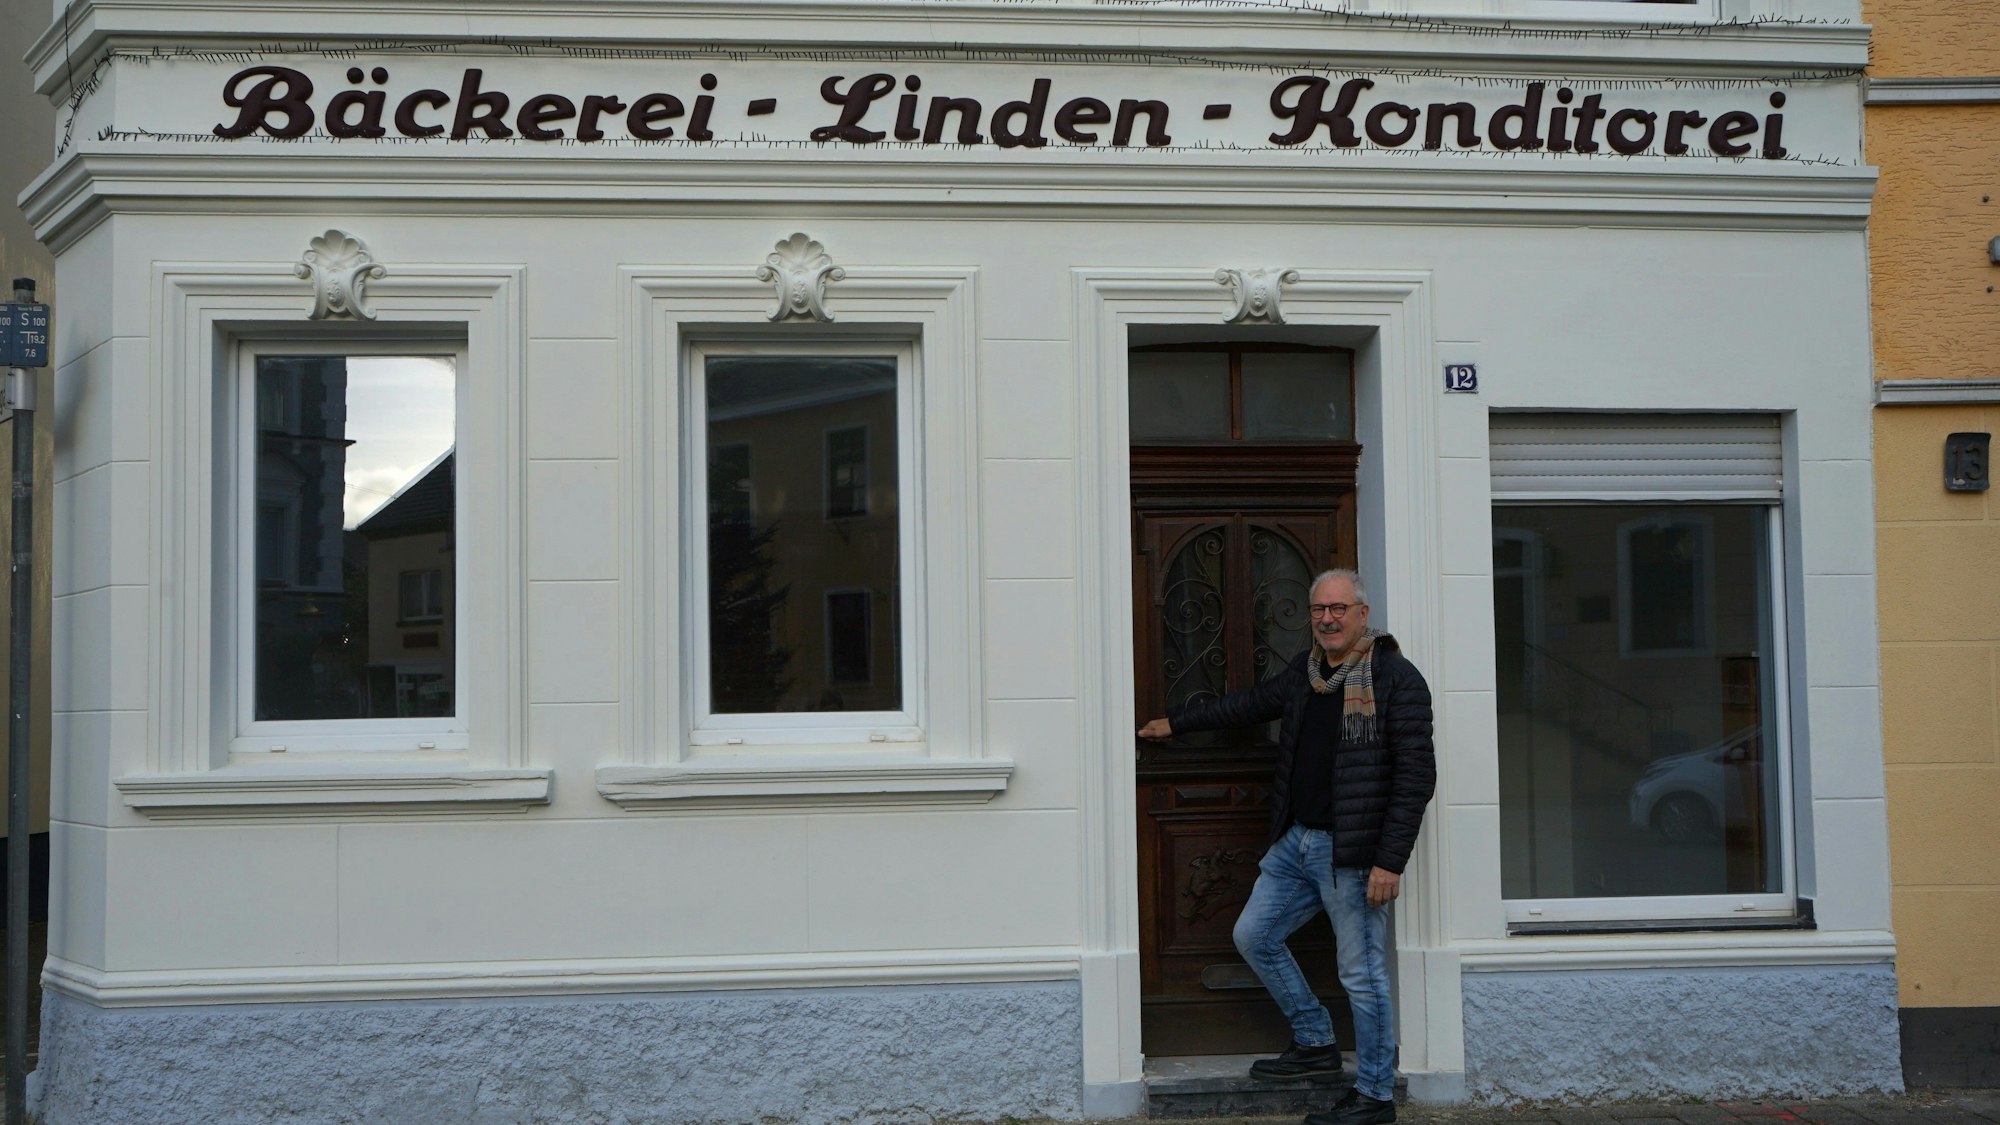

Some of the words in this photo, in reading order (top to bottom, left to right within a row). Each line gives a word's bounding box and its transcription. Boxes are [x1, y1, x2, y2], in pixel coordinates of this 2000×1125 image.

[213, 66, 717, 141] Bäckerei
[810, 73, 1171, 148] Linden
[1269, 75, 1787, 159] Konditorei
[21, 312, 29, 326] S
[33, 317, 46, 326] 100
[25, 348, 36, 357] 7.6
[1450, 367, 1473, 388] 12
[1952, 443, 1984, 481] 13
